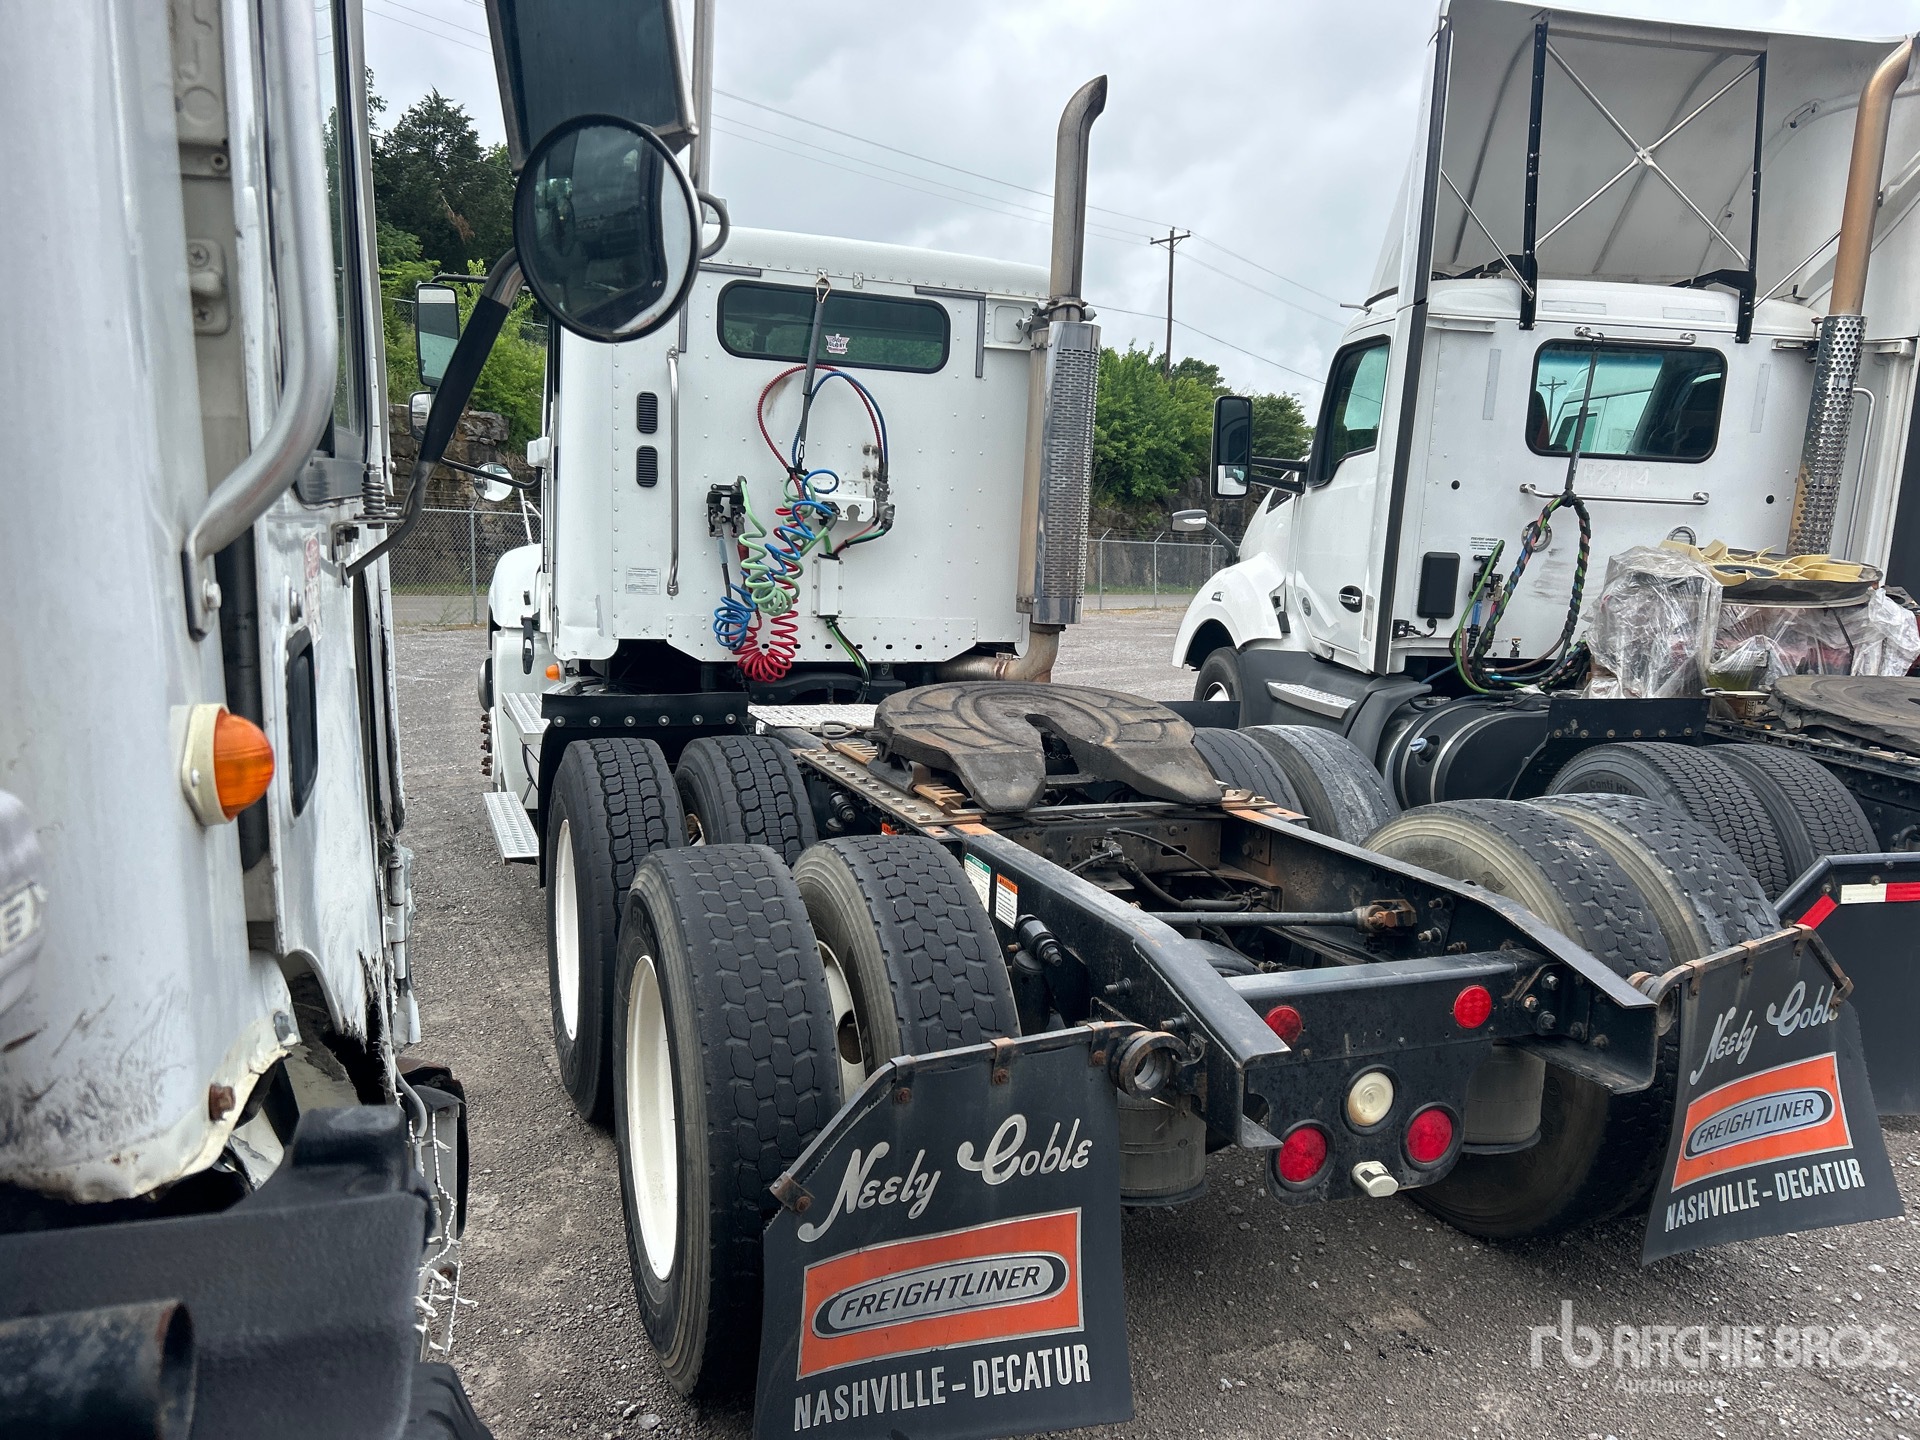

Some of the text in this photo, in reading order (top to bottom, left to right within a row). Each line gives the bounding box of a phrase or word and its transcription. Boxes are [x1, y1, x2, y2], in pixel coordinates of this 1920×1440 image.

[1589, 779, 1613, 791] Conti
[1690, 1006, 1758, 1086] Neely
[1697, 1098, 1815, 1147] FREIGHTLINER
[797, 1113, 1094, 1243] Neely Coble
[840, 1265, 1041, 1322] FREIGHTLINER
